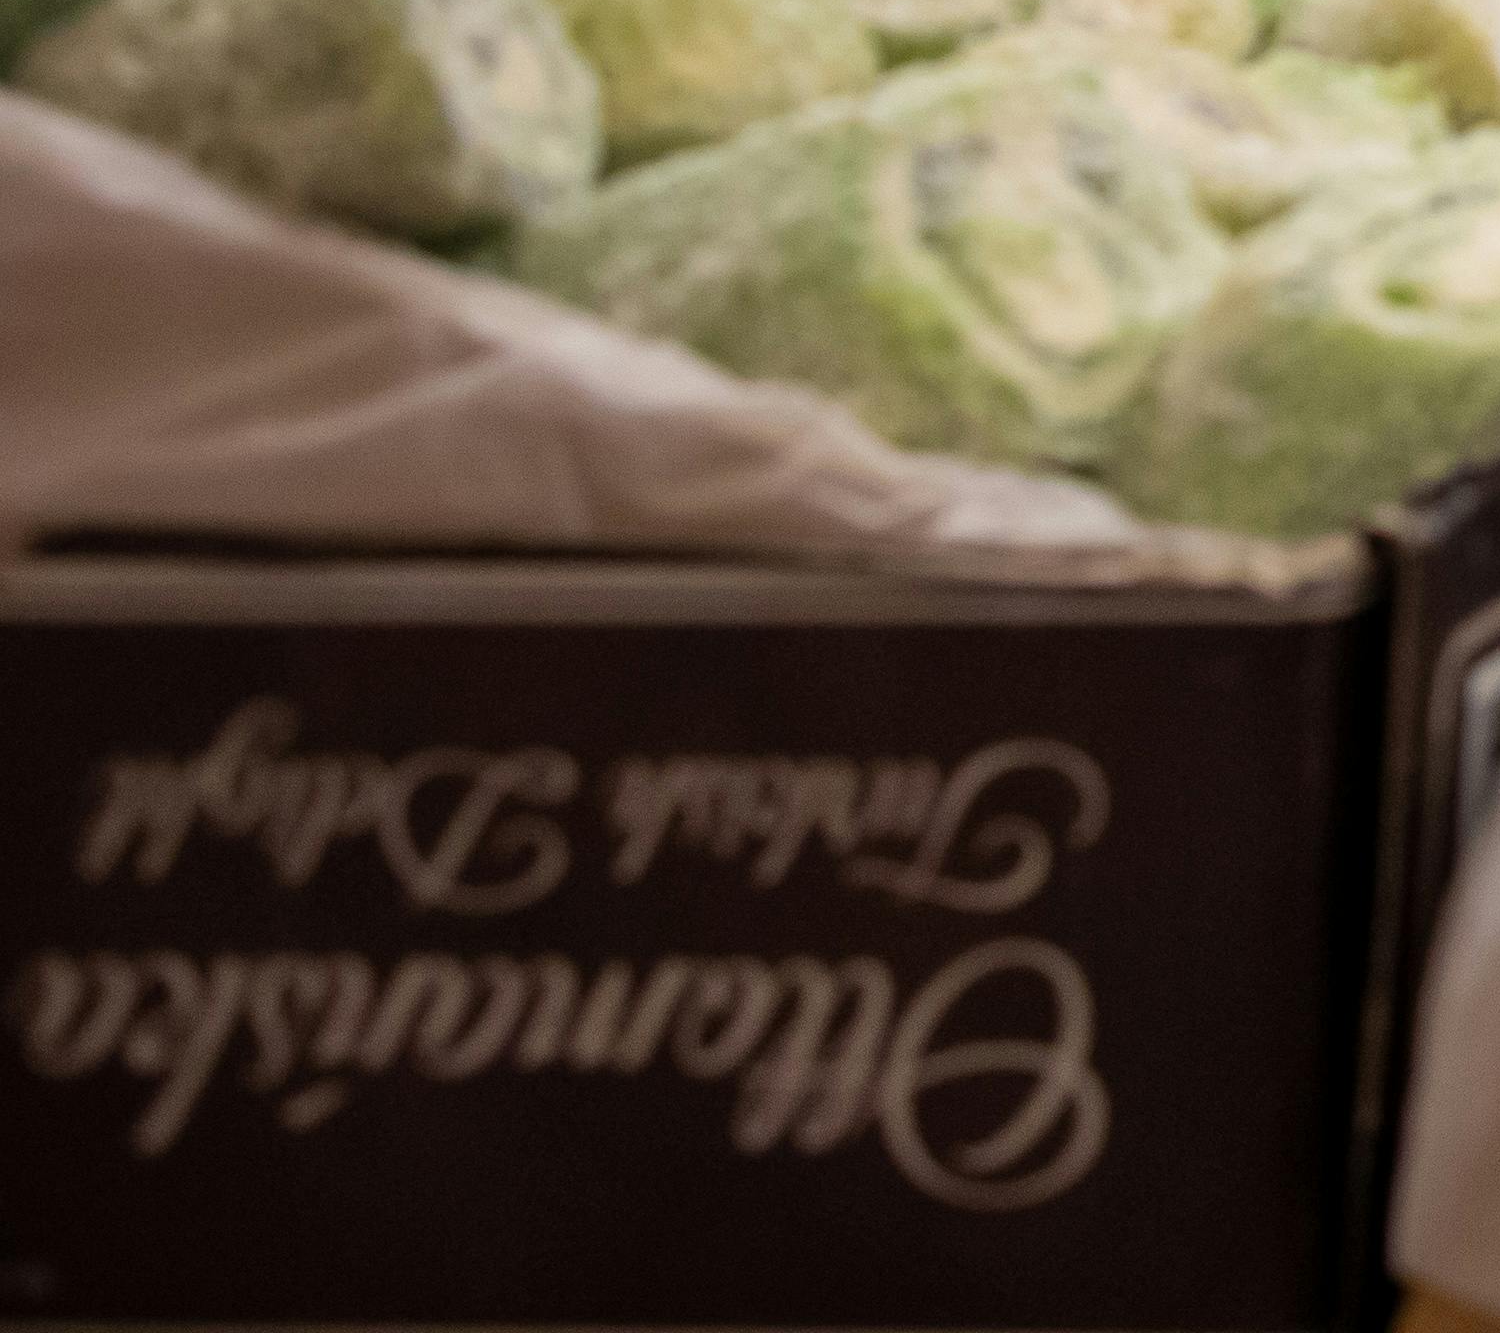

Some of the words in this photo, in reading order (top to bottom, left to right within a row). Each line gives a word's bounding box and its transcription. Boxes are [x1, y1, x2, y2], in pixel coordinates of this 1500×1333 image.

[76, 695, 582, 917] Delight
[603, 736, 1113, 917] Turkish
[13, 935, 1114, 1212] Ottomańska
